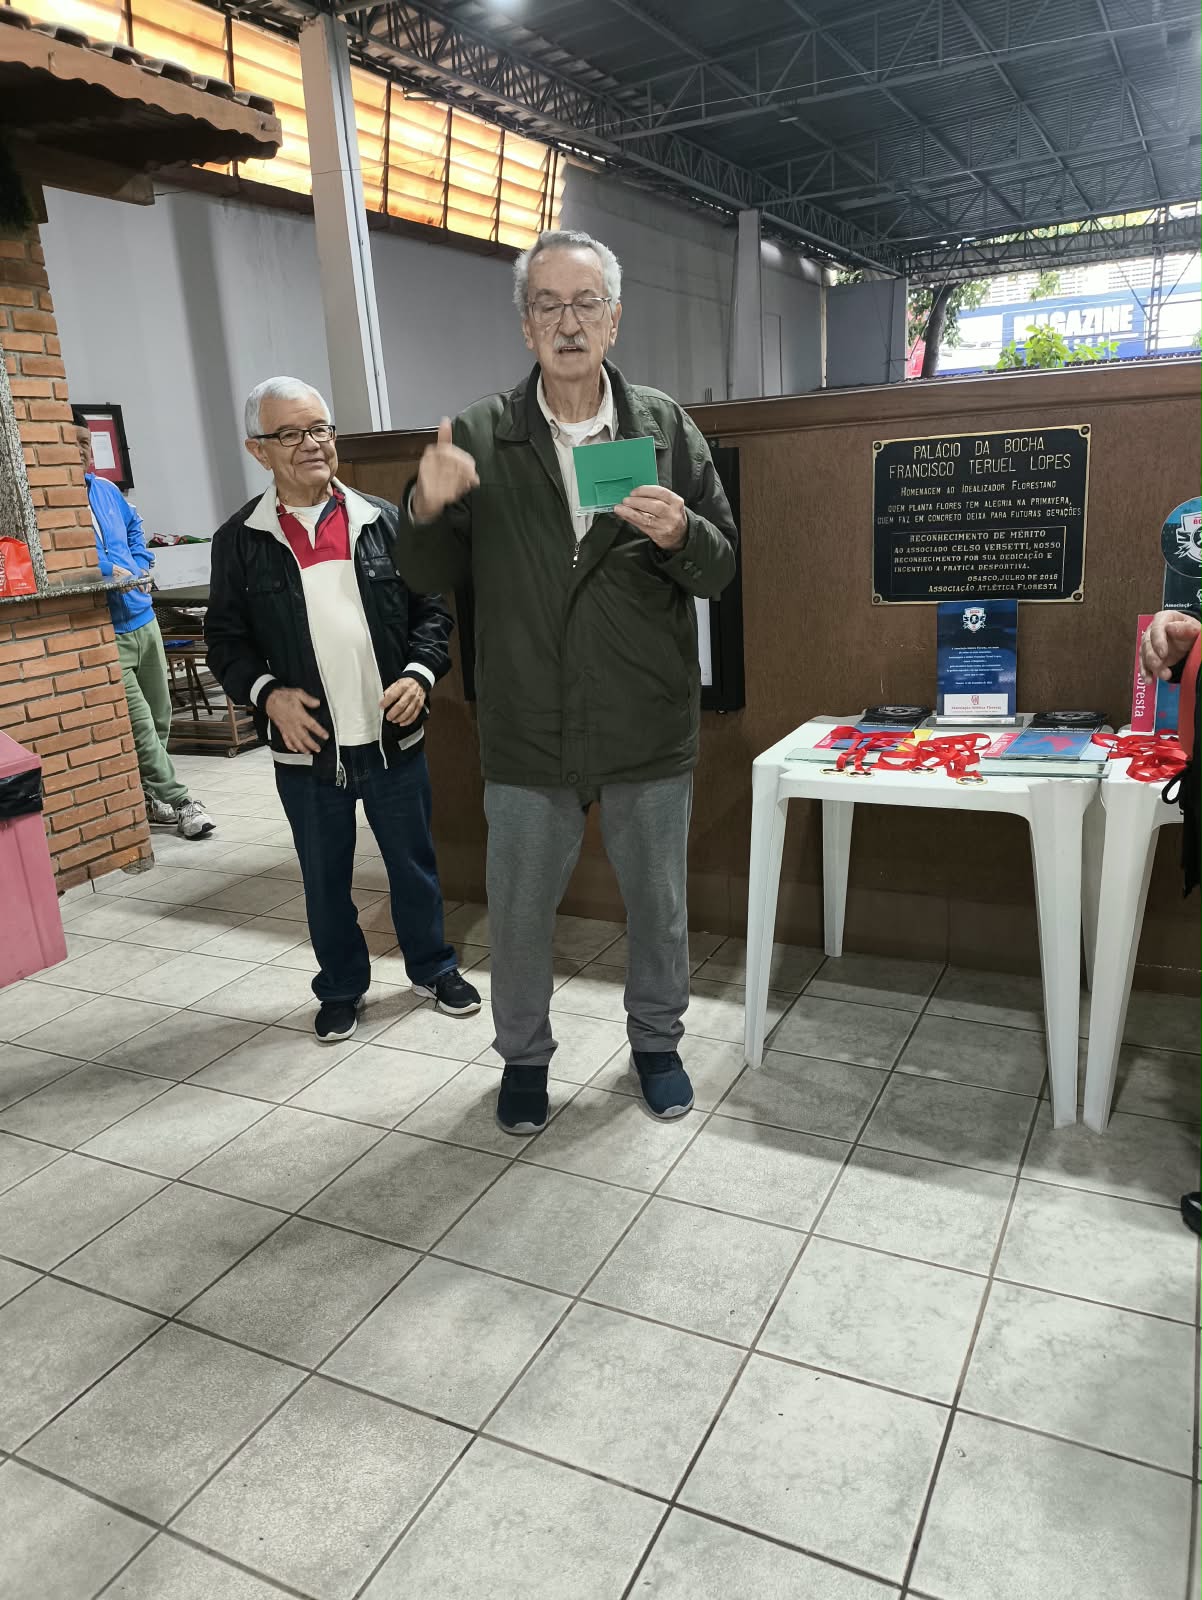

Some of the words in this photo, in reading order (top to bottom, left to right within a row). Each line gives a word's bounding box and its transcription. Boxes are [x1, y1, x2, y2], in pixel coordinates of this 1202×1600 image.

[1014, 304, 1134, 341] MAGAZINE
[913, 441, 961, 460] PALÁCIO
[975, 440, 990, 456] DA
[1004, 436, 1045, 453] BOCHA
[889, 461, 955, 479] FRANCISCO
[969, 457, 1016, 475] TERUEL
[1030, 453, 1072, 471] LOPES
[946, 486, 955, 494] AO
[888, 504, 905, 513] QUEM
[908, 503, 933, 512] PLANTA
[936, 502, 962, 510] FLORES
[965, 501, 979, 509] TEM
[984, 500, 1012, 508] ALEGRIA
[1030, 496, 1072, 506] PRIMAVERA,
[877, 516, 894, 525] QUEM
[898, 516, 910, 524] FAZ
[915, 515, 924, 523] EM
[927, 513, 962, 522] CONCRETO
[966, 513, 986, 521] DEIXA
[990, 511, 1007, 519] PARA
[1010, 510, 1041, 518] FUTURAS
[1046, 506, 1082, 518] GERAÇÕES
[909, 532, 989, 543] RECONHECIMENTO
[993, 532, 1006, 540] DE
[1010, 530, 1046, 539] MÉRITO
[894, 555, 961, 564] RECONHECIMENTO
[1000, 551, 1044, 560] DEDICAÇÃO
[894, 565, 933, 573] INCENTIVO
[928, 584, 975, 593] ASSOCIAÇÃO
[1134, 673, 1146, 717] oresta
